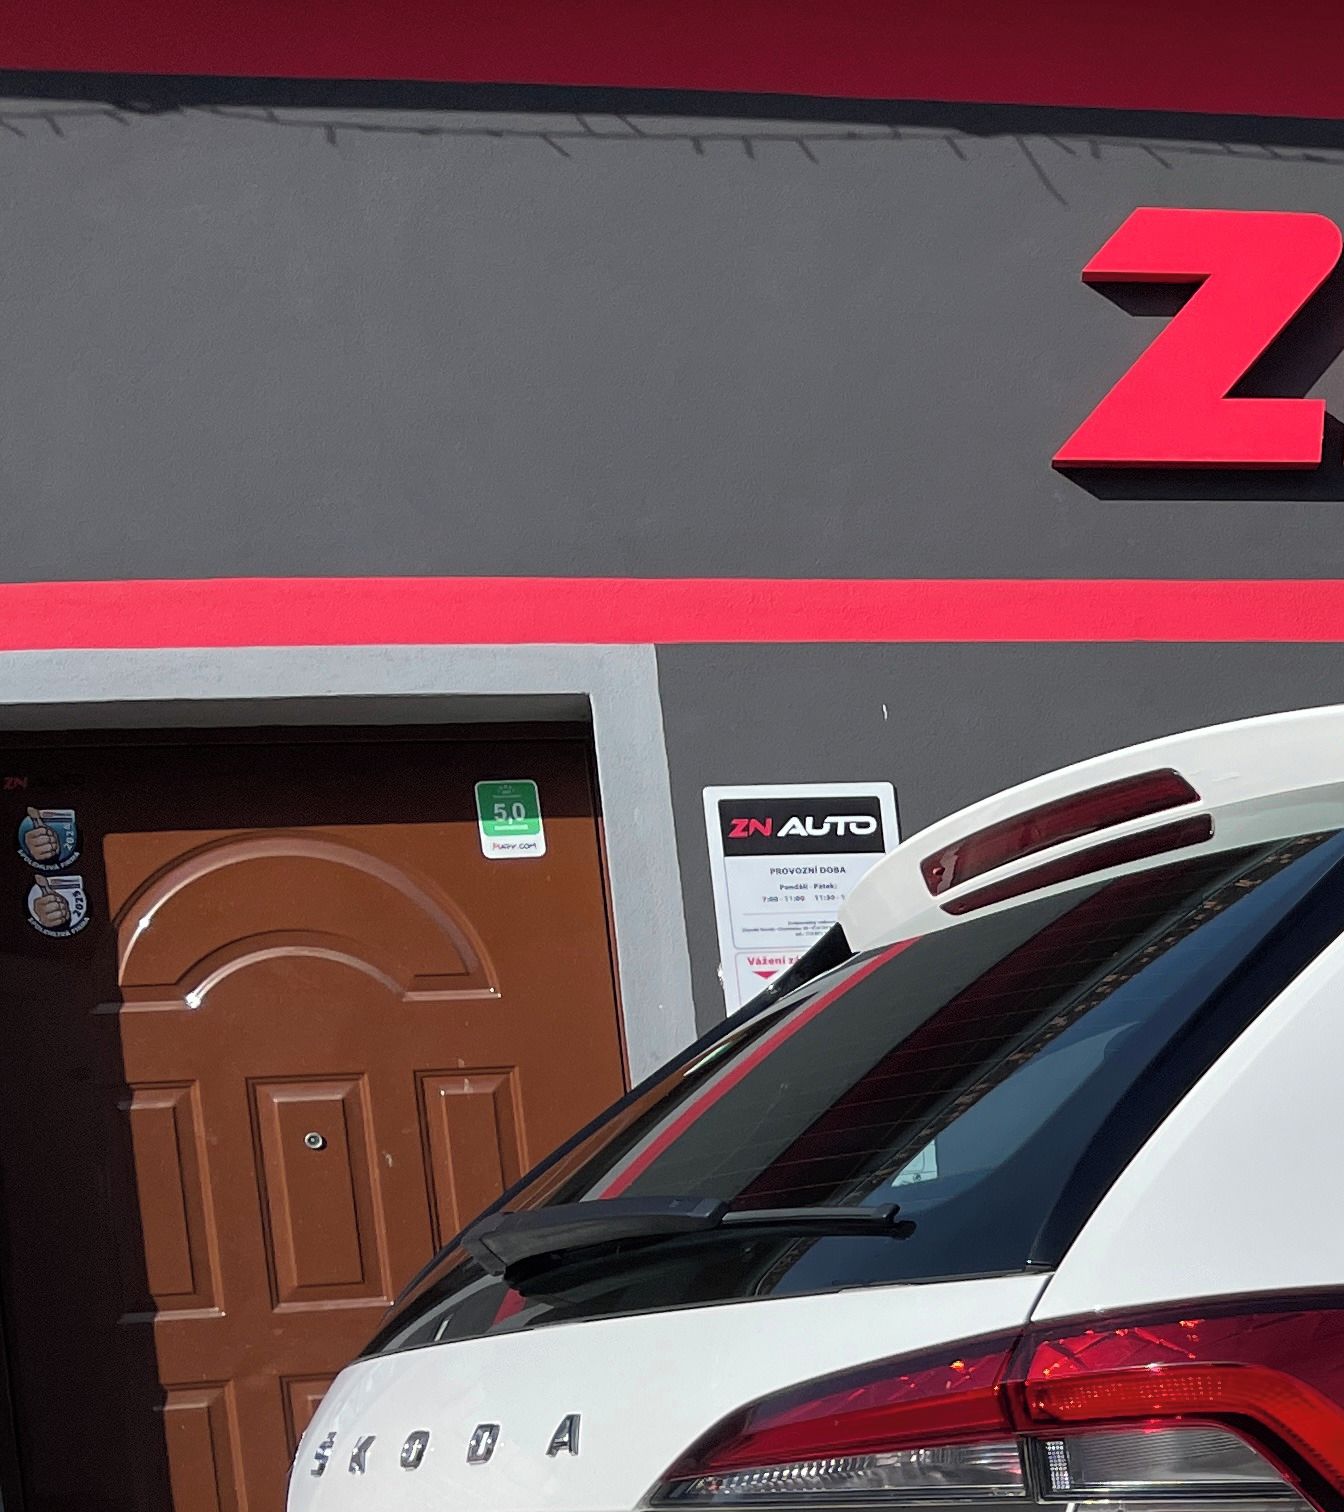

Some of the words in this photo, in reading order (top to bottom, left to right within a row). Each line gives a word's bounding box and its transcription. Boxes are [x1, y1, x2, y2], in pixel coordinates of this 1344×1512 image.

[728, 818, 772, 838] ZN
[777, 815, 877, 837] AUTO
[770, 866, 818, 875] PROVOZNÍ
[819, 866, 846, 874] DOBA
[747, 956, 786, 966] Vážení
